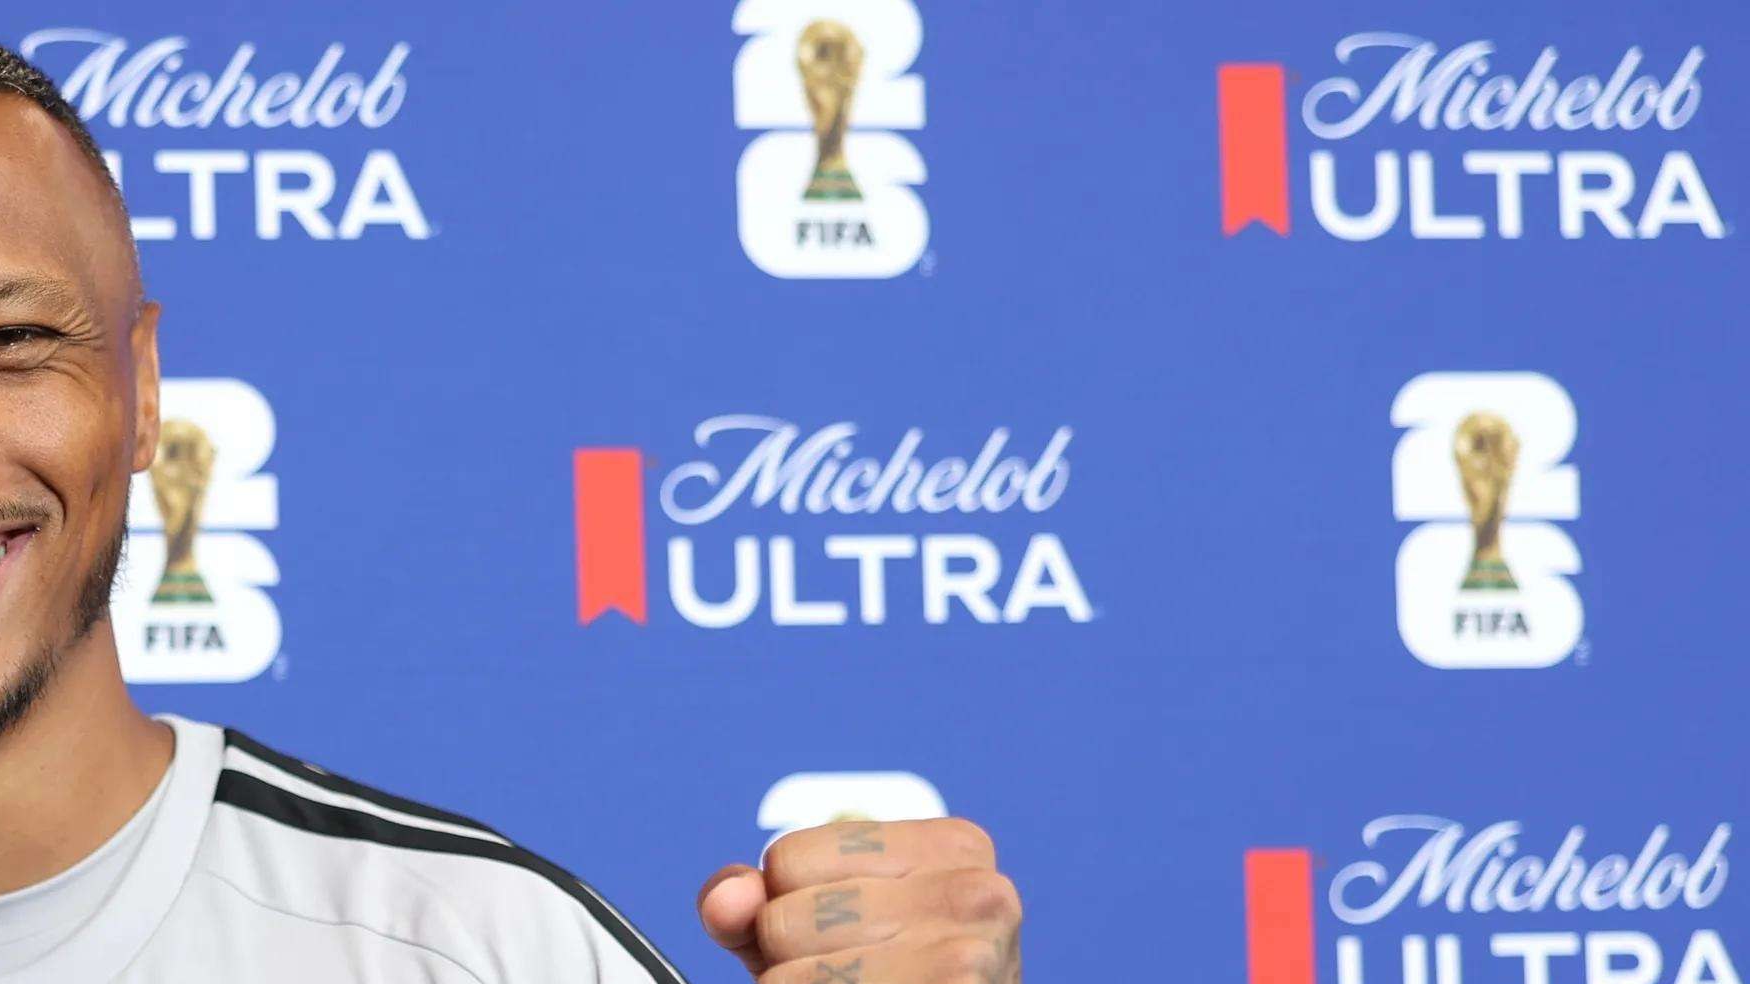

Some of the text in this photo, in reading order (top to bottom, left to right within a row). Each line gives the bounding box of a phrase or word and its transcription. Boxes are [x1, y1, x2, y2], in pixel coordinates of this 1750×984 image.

[1301, 32, 1705, 140] Michelob
[795, 219, 875, 248] FIFA
[1308, 150, 1725, 242] ULTRA
[659, 414, 1073, 525] Michelob
[667, 533, 1094, 629] ULTRA
[1453, 611, 1531, 637] FIFA
[144, 623, 227, 652] FIFA
[1328, 814, 1732, 926] Michelob
